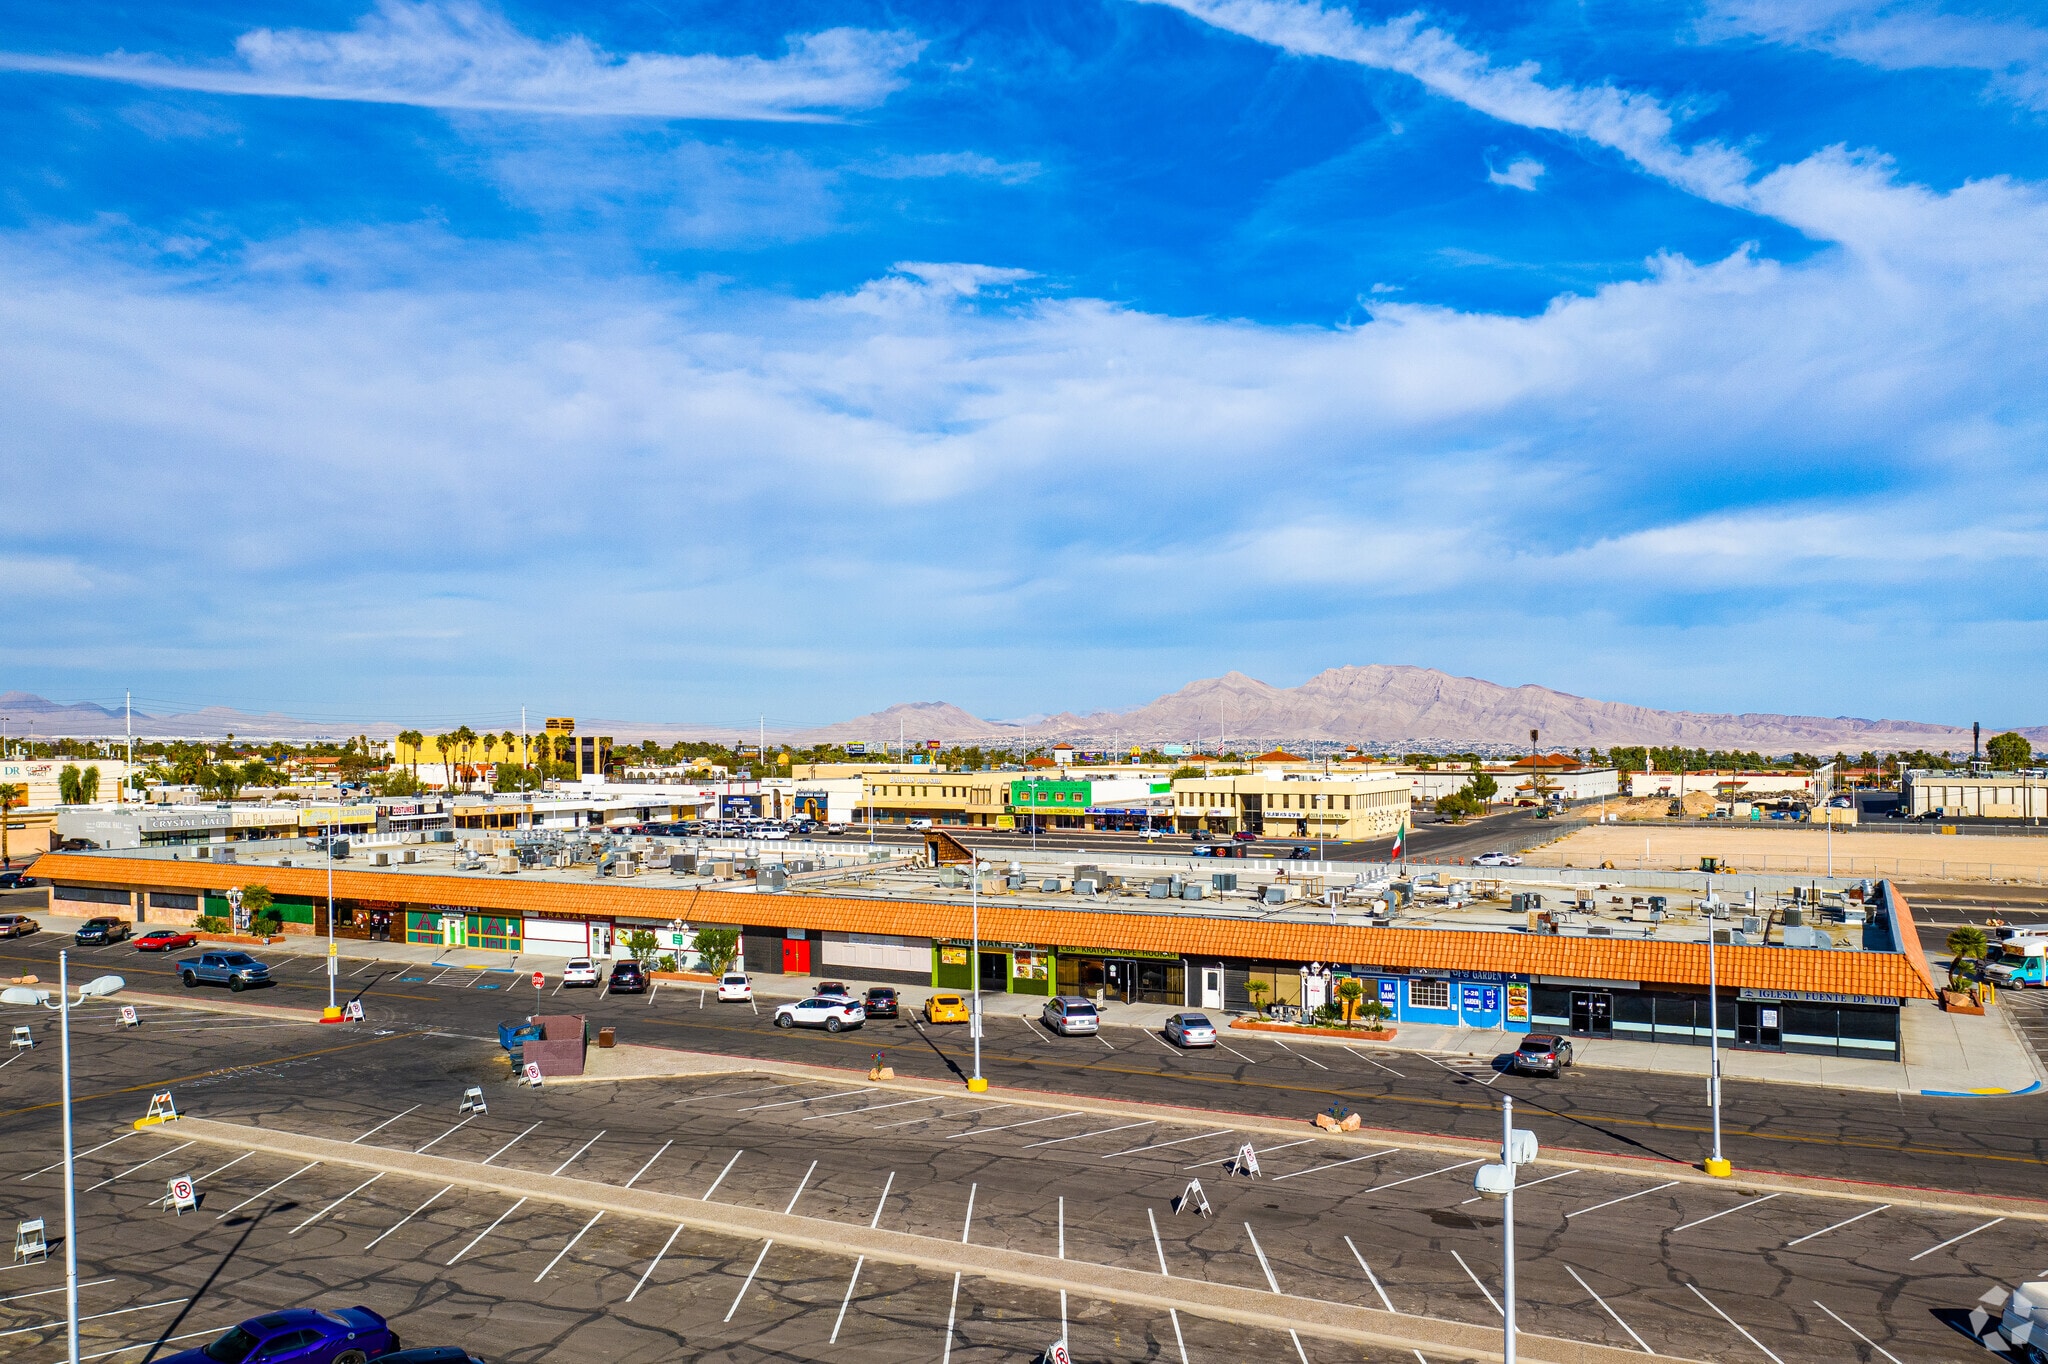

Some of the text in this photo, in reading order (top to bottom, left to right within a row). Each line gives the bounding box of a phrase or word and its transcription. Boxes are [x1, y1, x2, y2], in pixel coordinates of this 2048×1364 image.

[152, 818, 195, 828] CRYSTAL
[202, 817, 226, 826] HALL
[1361, 965, 1381, 973] Korean
[1472, 970, 1502, 980] GARDEN
[1384, 983, 1392, 991] MA
[1381, 992, 1395, 1000] DANG
[1759, 990, 1898, 1005] IGLESIA FUENTE DE VIDA
